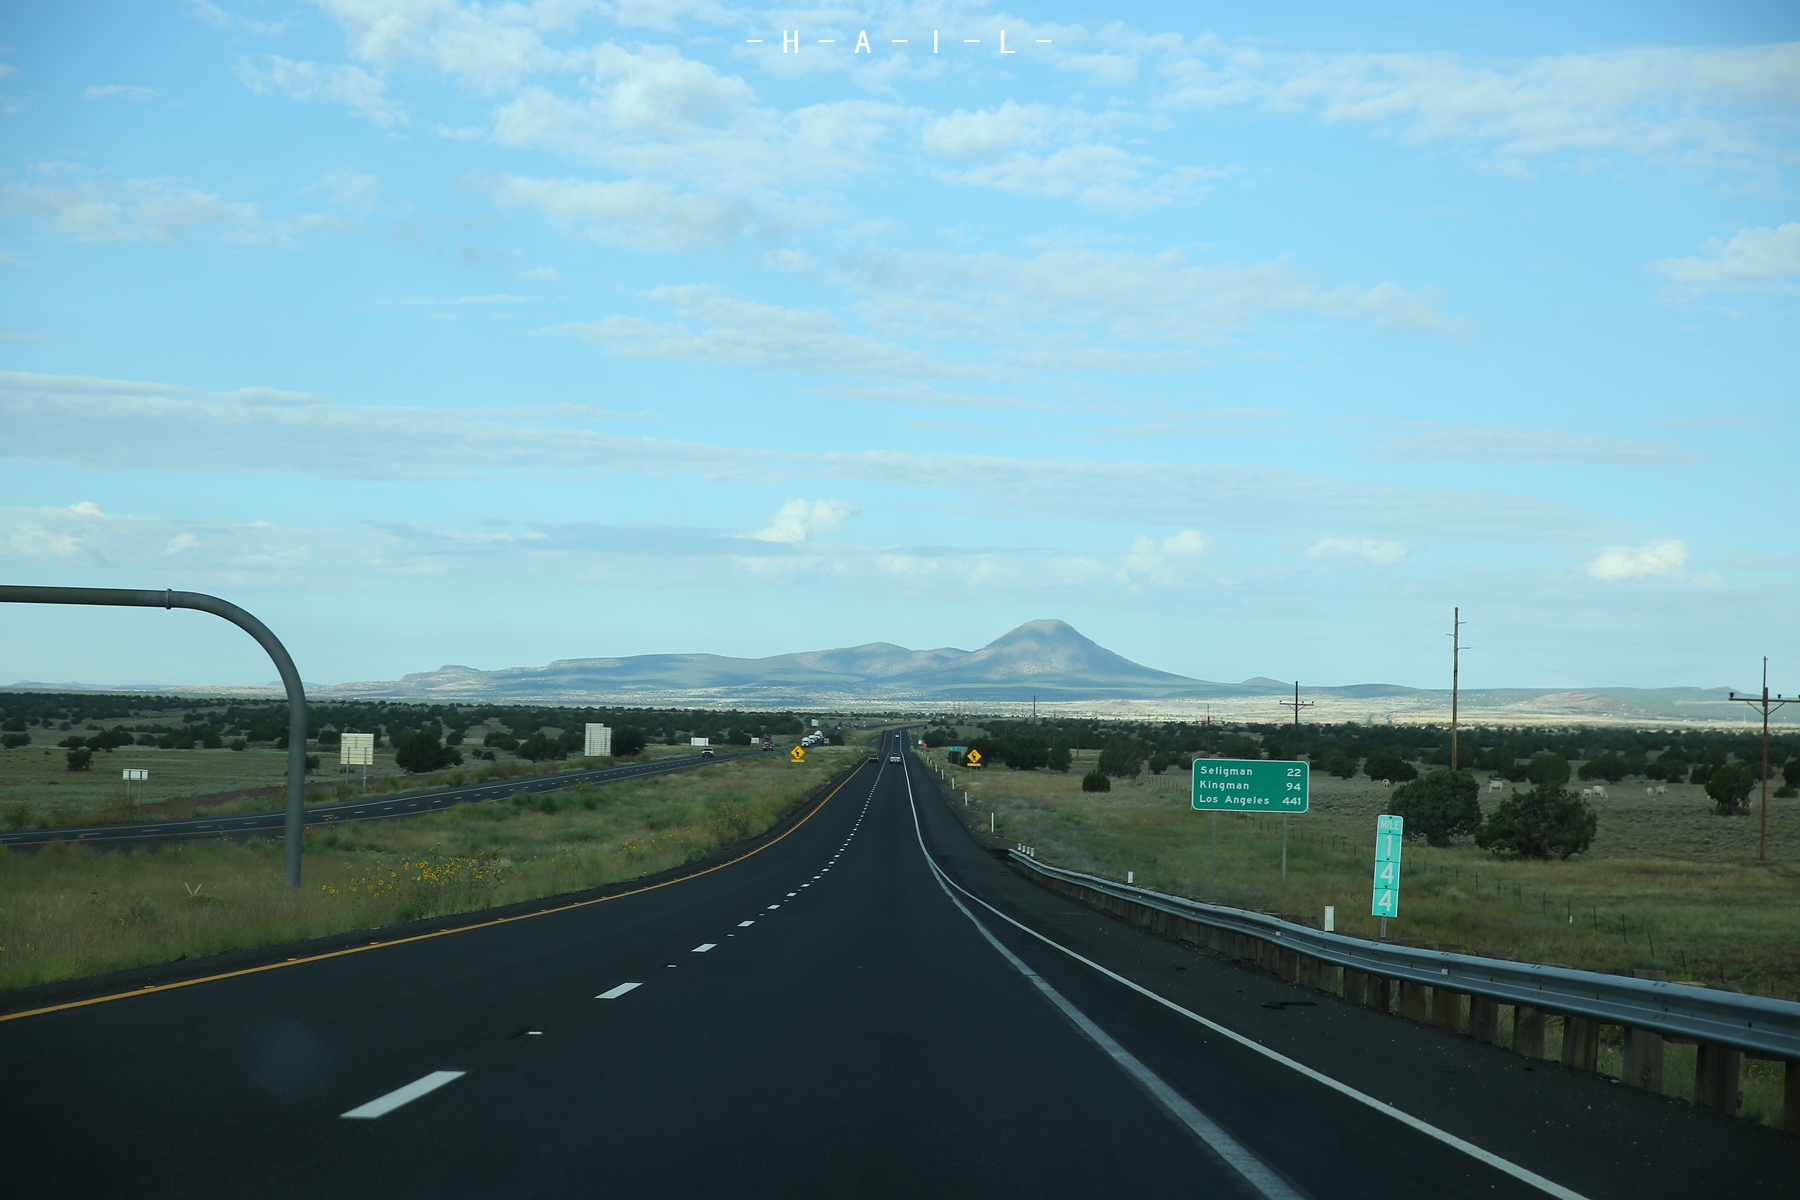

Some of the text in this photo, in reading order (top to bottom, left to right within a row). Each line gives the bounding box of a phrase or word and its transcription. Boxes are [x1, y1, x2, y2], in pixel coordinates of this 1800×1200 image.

[1200, 766, 1302, 777] Seligman 22
[1200, 780, 1302, 791] Kingman 94
[1199, 795, 1301, 806] Los Angeles 441
[1380, 820, 1400, 830] MILE
